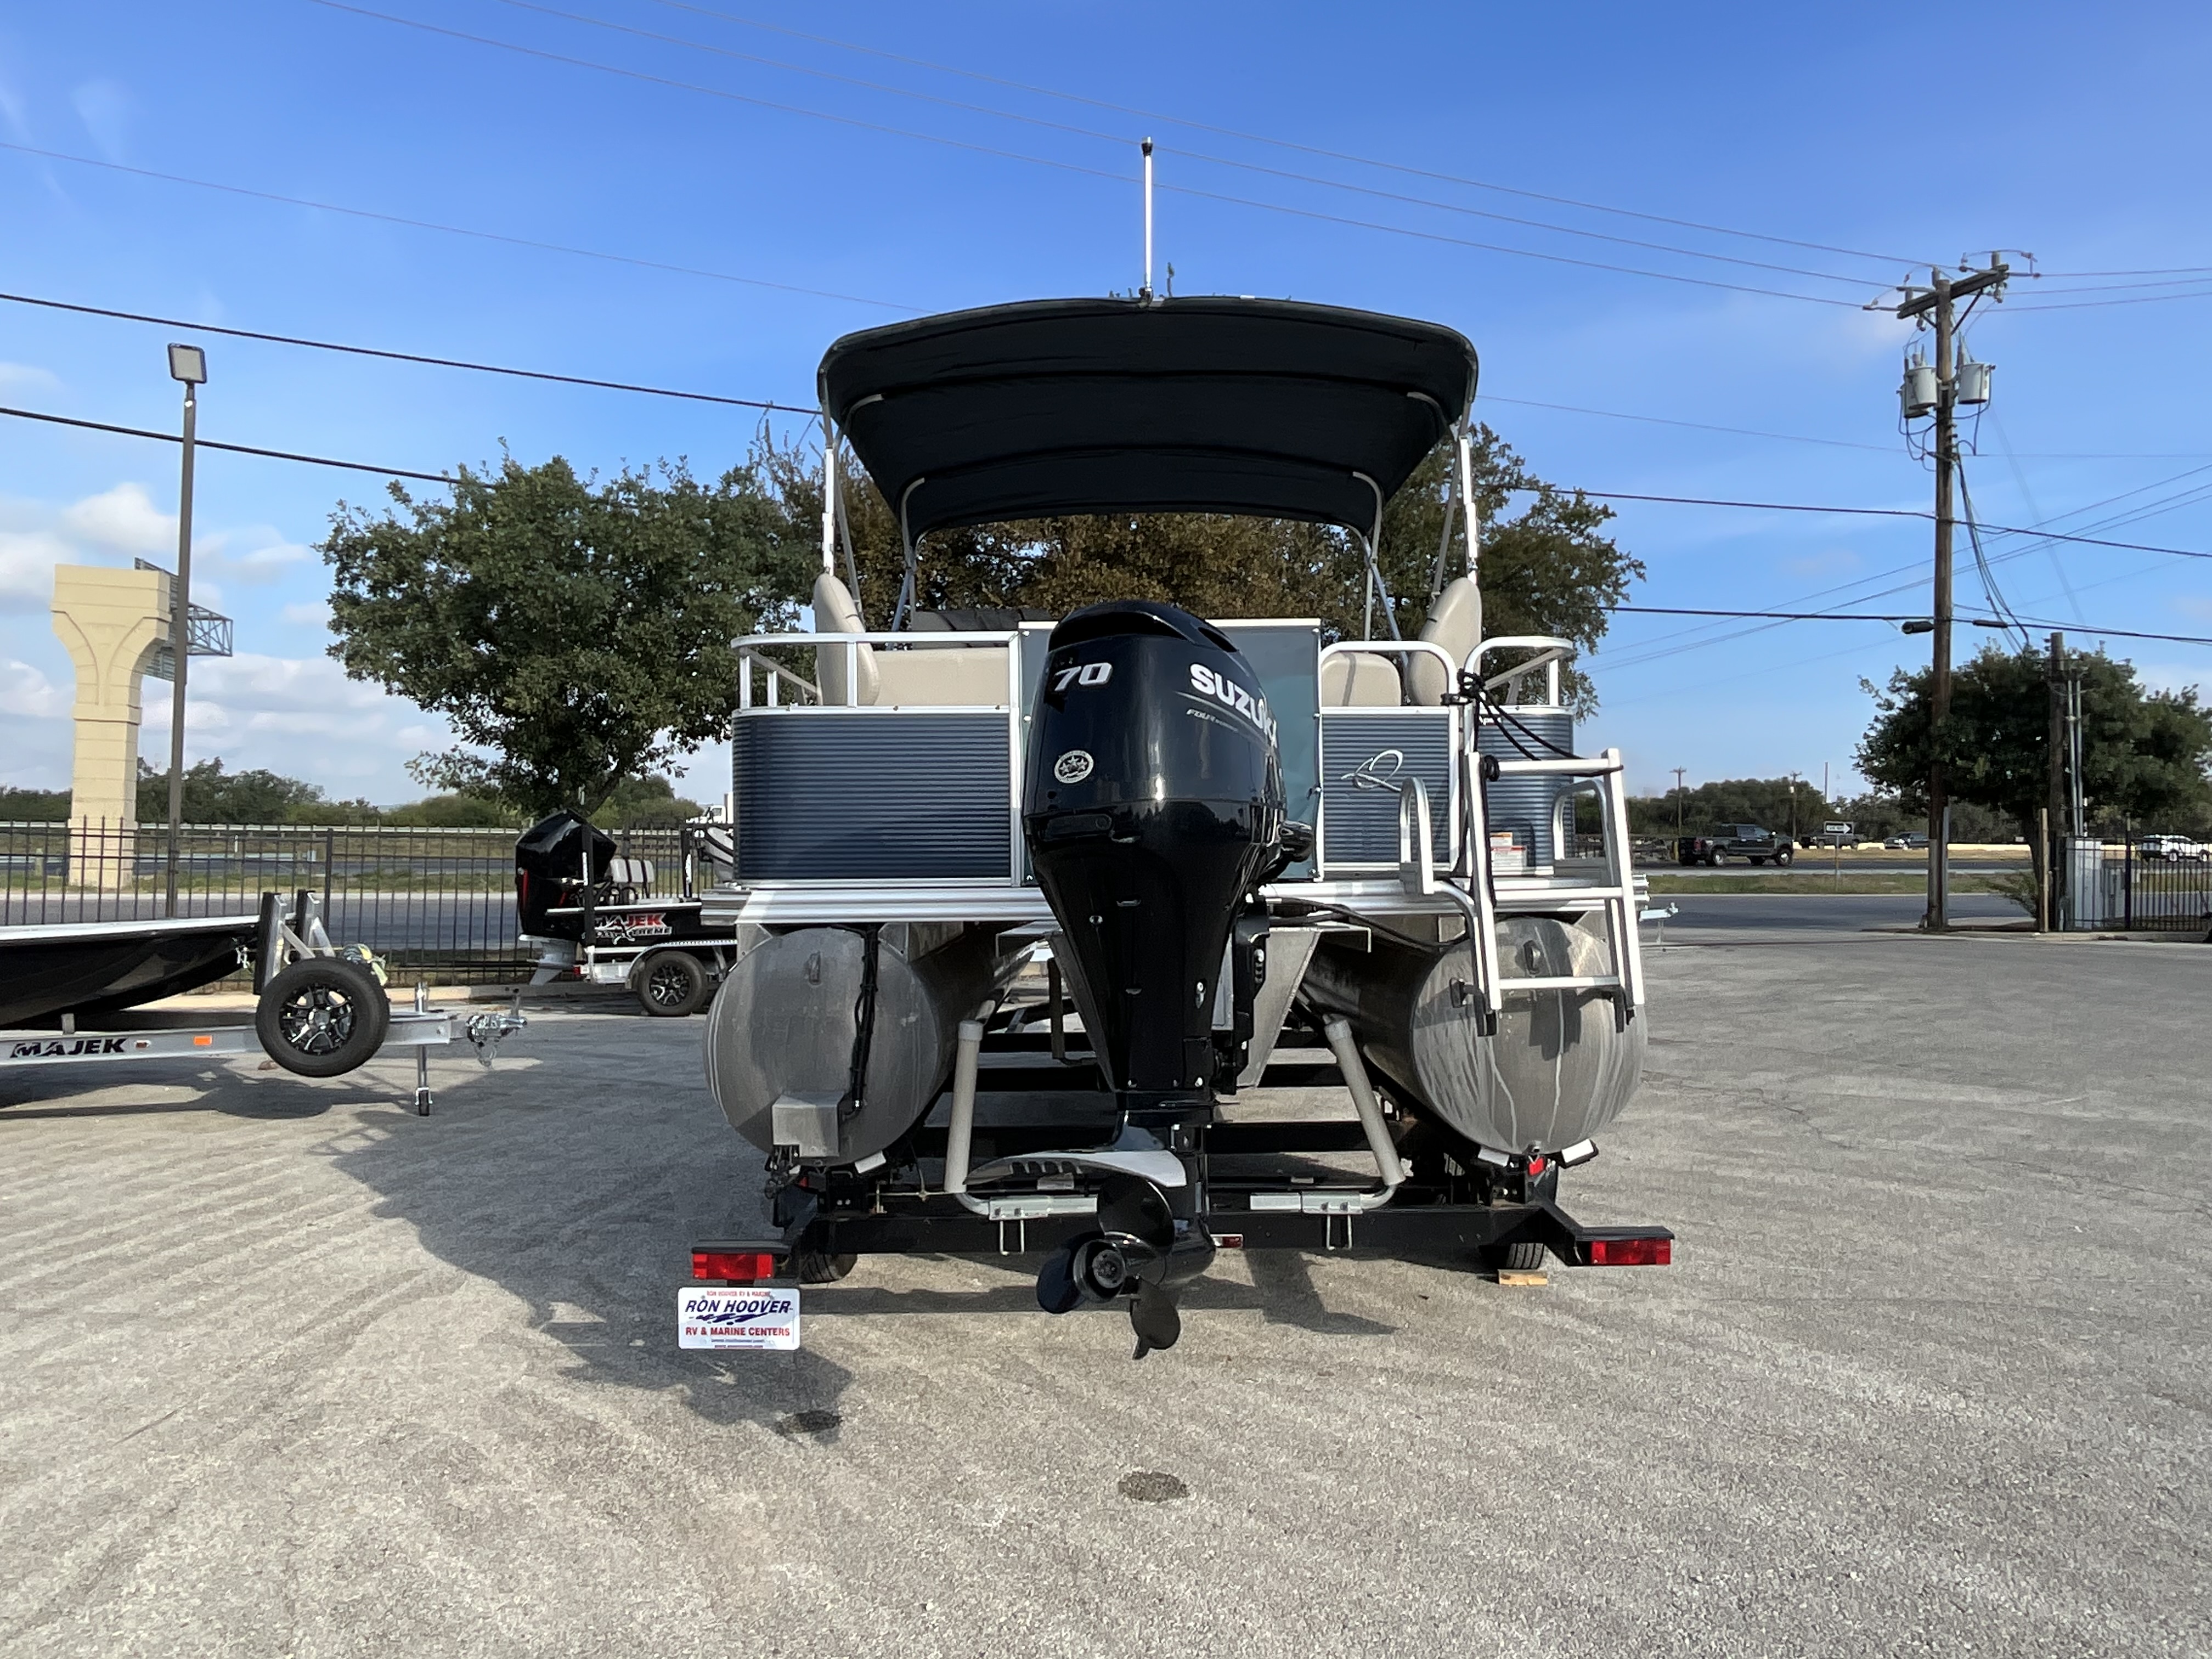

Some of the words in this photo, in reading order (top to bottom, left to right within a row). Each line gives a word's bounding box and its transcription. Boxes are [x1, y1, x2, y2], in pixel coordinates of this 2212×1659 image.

[1054, 662, 1113, 691] 70
[10, 1039, 129, 1058] MAJEK
[685, 1300, 720, 1312] RON
[723, 1300, 791, 1313] HOOVER
[686, 1327, 698, 1336] RV
[701, 1327, 707, 1336] &
[710, 1327, 746, 1336] MARINE
[748, 1327, 790, 1336] CENTERS
